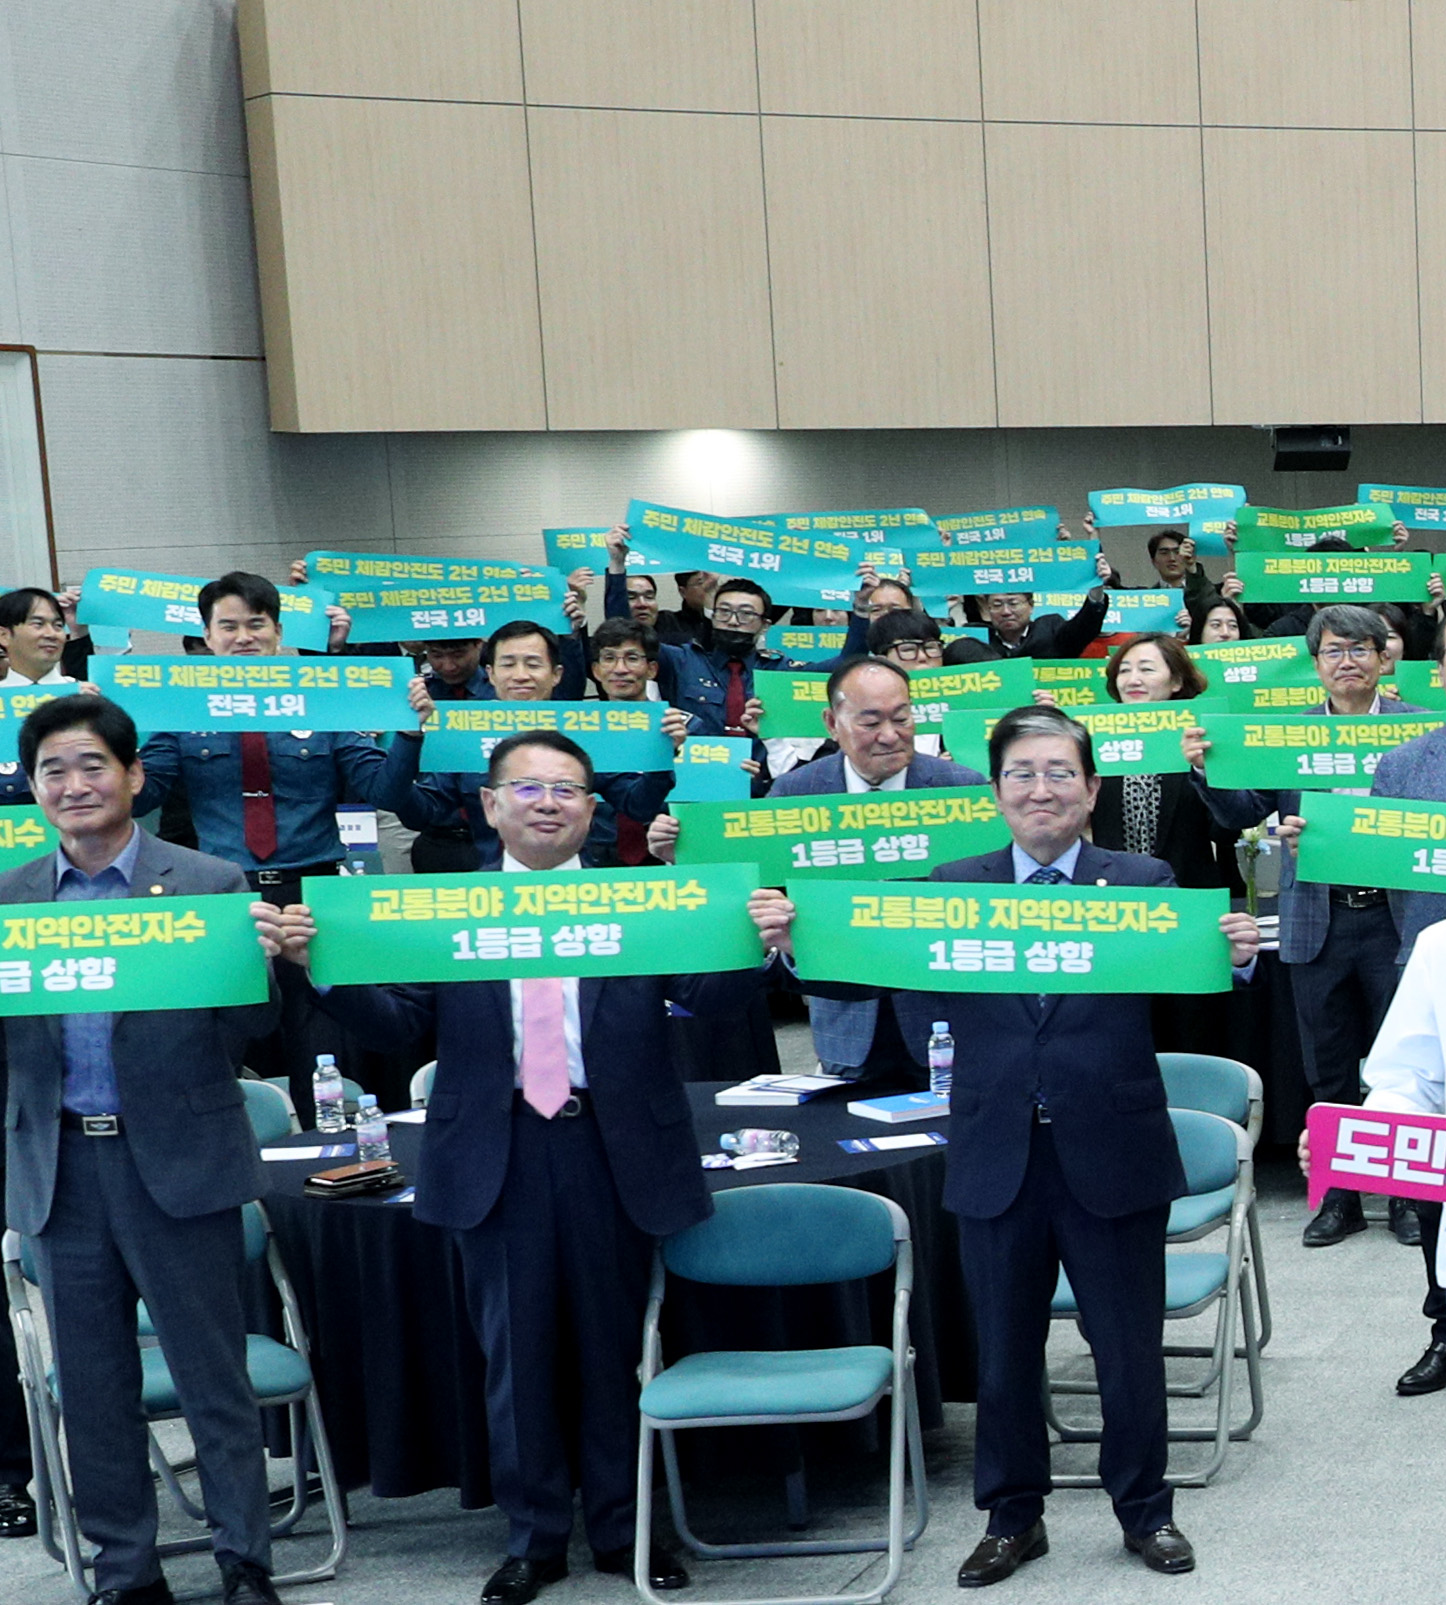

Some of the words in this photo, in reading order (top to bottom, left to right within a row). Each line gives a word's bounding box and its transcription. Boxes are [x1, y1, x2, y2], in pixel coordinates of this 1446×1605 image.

[1146, 505, 1170, 517] 전국
[1173, 505, 1193, 516] 1위
[643, 507, 678, 531] 주민
[682, 517, 774, 547] 체감안전도
[778, 536, 810, 558] 2년
[814, 541, 850, 561] 연속
[708, 541, 744, 565] 전국
[749, 552, 780, 571] 1위
[917, 552, 945, 567] 주민
[949, 549, 1024, 568] 체감안전도
[1028, 548, 1053, 562] 2년
[1057, 547, 1087, 562] 연속
[1265, 559, 1322, 574] 교통분야
[1326, 559, 1411, 573] 지역안전지수
[974, 569, 1003, 584] 전국
[1008, 567, 1033, 582] 1위
[1300, 578, 1339, 593] 1등급
[1343, 578, 1373, 593] 상향
[336, 592, 375, 611] 주민
[380, 583, 474, 606] 체감안전도
[478, 585, 509, 602] 2년
[513, 584, 550, 601] 연속
[412, 610, 448, 628] 전국
[454, 608, 485, 626] 1위
[114, 665, 162, 687] 주민
[169, 665, 292, 687] 체감안전도
[299, 666, 338, 687] 2년
[345, 666, 392, 687] 연속
[208, 695, 256, 716] 전국
[264, 694, 305, 716] 1위
[723, 807, 831, 841] 교통분야
[838, 795, 999, 829] 지역안전지수
[792, 839, 864, 867] 1등급
[872, 834, 929, 862] 상향
[370, 886, 504, 920] 교통분야
[513, 880, 707, 915] 지역안전지수
[851, 896, 979, 929] 교통분야
[989, 899, 1178, 933] 지역안전지수
[2, 911, 206, 949] 지역안전지수
[453, 927, 542, 959] 1등급
[551, 923, 622, 956] 상향
[929, 940, 1015, 971] 1등급
[1024, 941, 1093, 973] 상향
[41, 957, 116, 991] 상향
